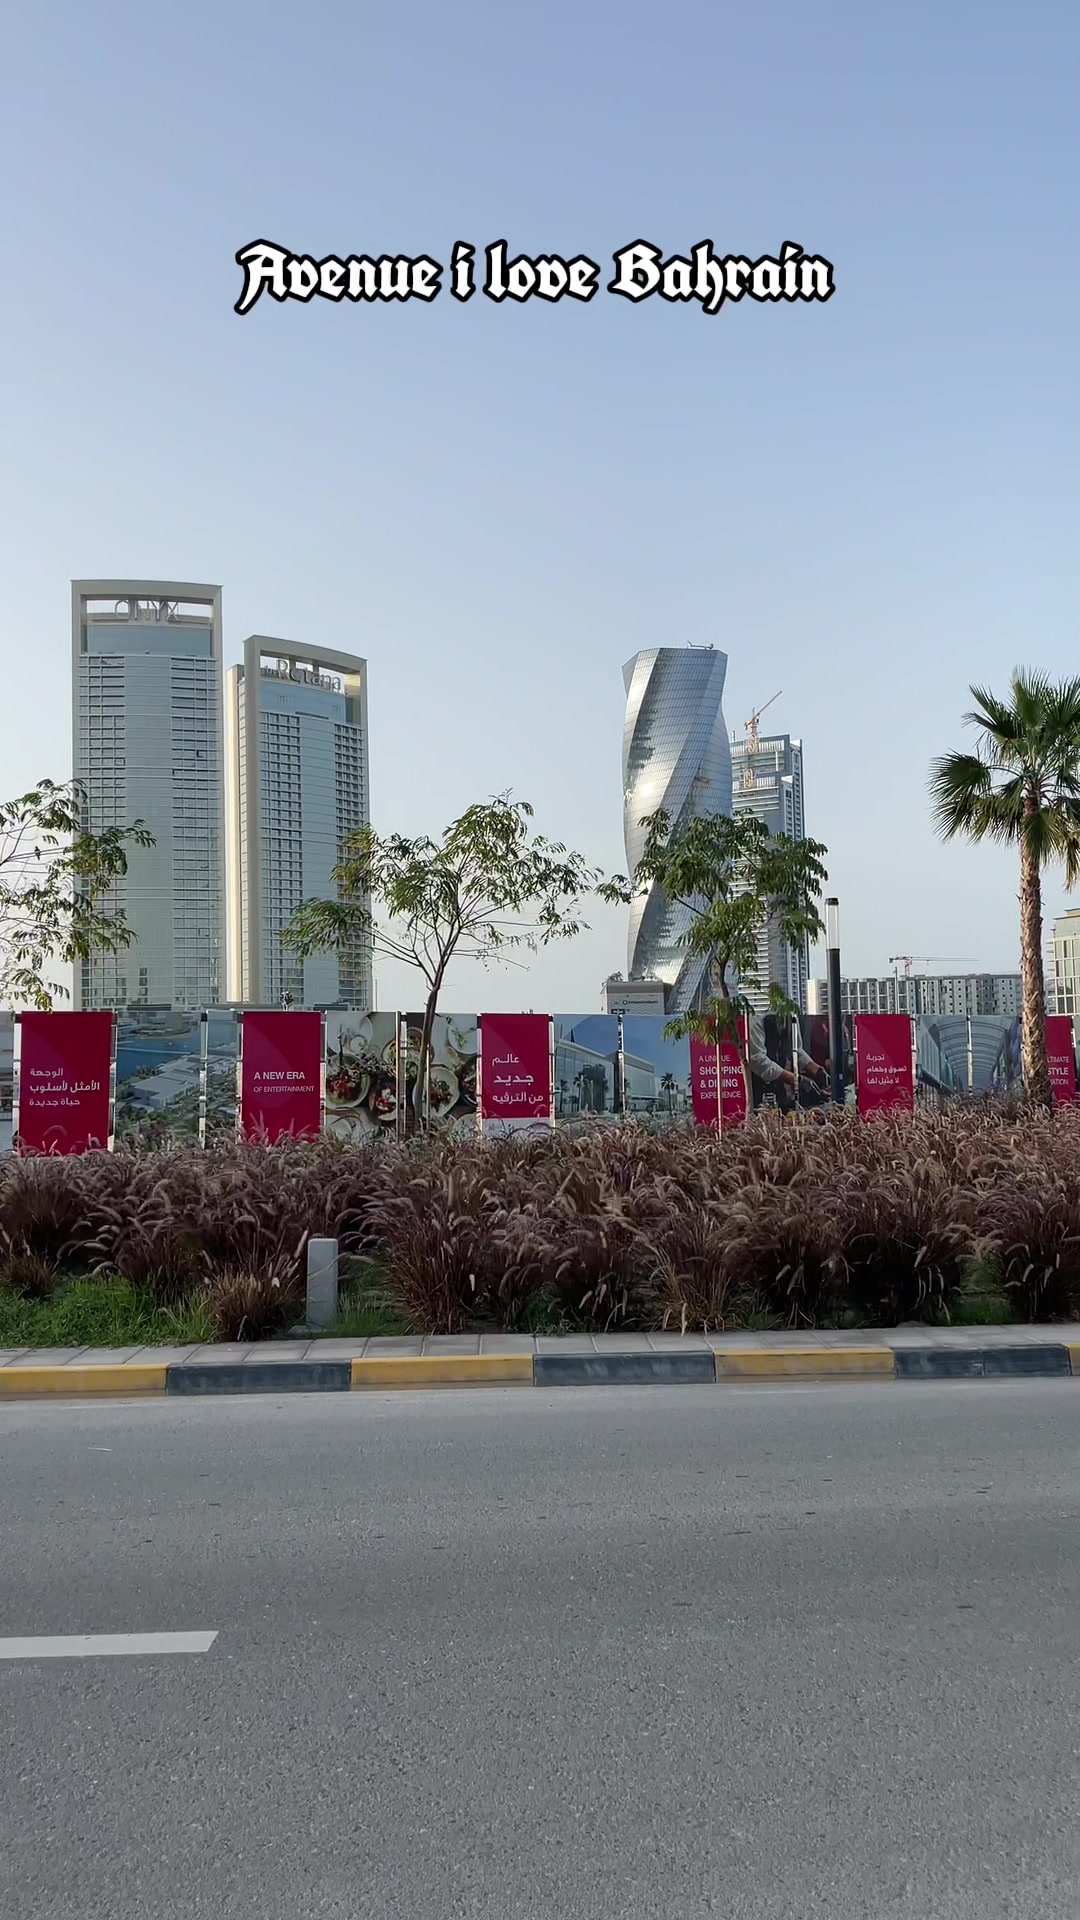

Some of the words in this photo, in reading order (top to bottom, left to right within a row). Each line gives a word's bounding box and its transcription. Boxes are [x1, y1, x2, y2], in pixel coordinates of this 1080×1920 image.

[114, 599, 179, 621] ONYX
[276, 659, 341, 692] Rotana
[492, 1053, 520, 1067] عالم
[704, 1054, 731, 1062] UNIUE
[29, 1068, 64, 1079] الوجهة
[253, 1071, 261, 1080] A
[262, 1071, 285, 1080] NEW
[286, 1071, 306, 1080] ERA
[700, 1066, 743, 1075] SHOPING
[1047, 1067, 1069, 1076] STYLE
[494, 1075, 535, 1087] جديد
[700, 1079, 707, 1088] &
[708, 1079, 739, 1088] DIING
[29, 1080, 68, 1094] لأسلوب
[69, 1080, 100, 1093] الأمثل
[263, 1085, 315, 1093] ENTERTAINMENT
[492, 1092, 527, 1104] الترفيه
[528, 1094, 544, 1104] من
[700, 1091, 742, 1099] EXPEIENCE
[29, 1098, 59, 1107] جديدة
[60, 1097, 81, 1107] حياة
